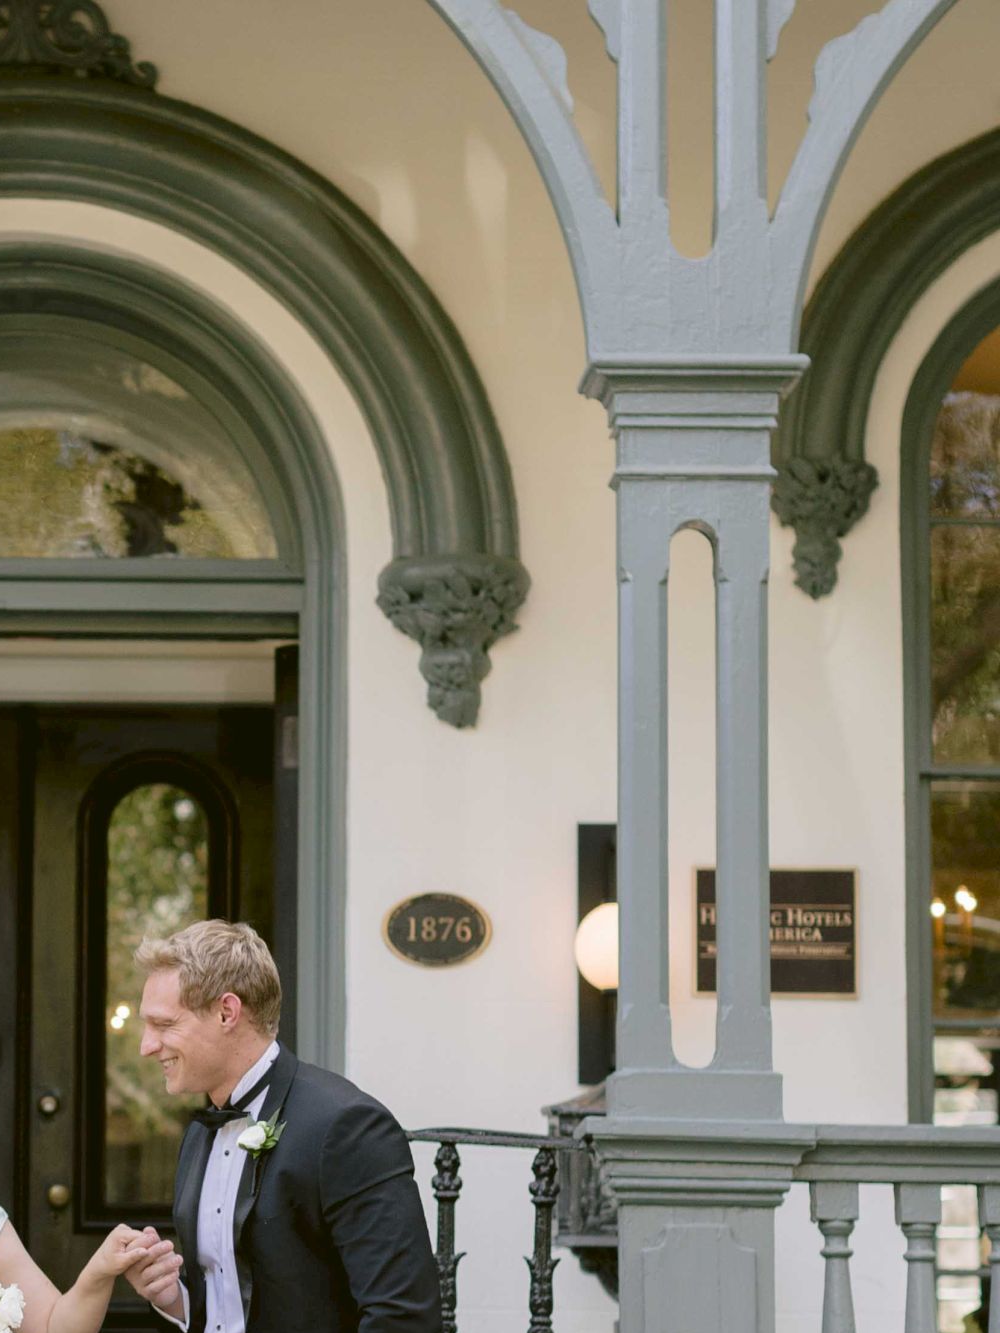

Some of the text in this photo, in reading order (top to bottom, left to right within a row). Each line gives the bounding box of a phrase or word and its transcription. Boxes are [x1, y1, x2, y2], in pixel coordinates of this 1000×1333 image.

[787, 907, 852, 926] HOTELS
[407, 916, 473, 943] 1876
[769, 927, 823, 941] ERICA
